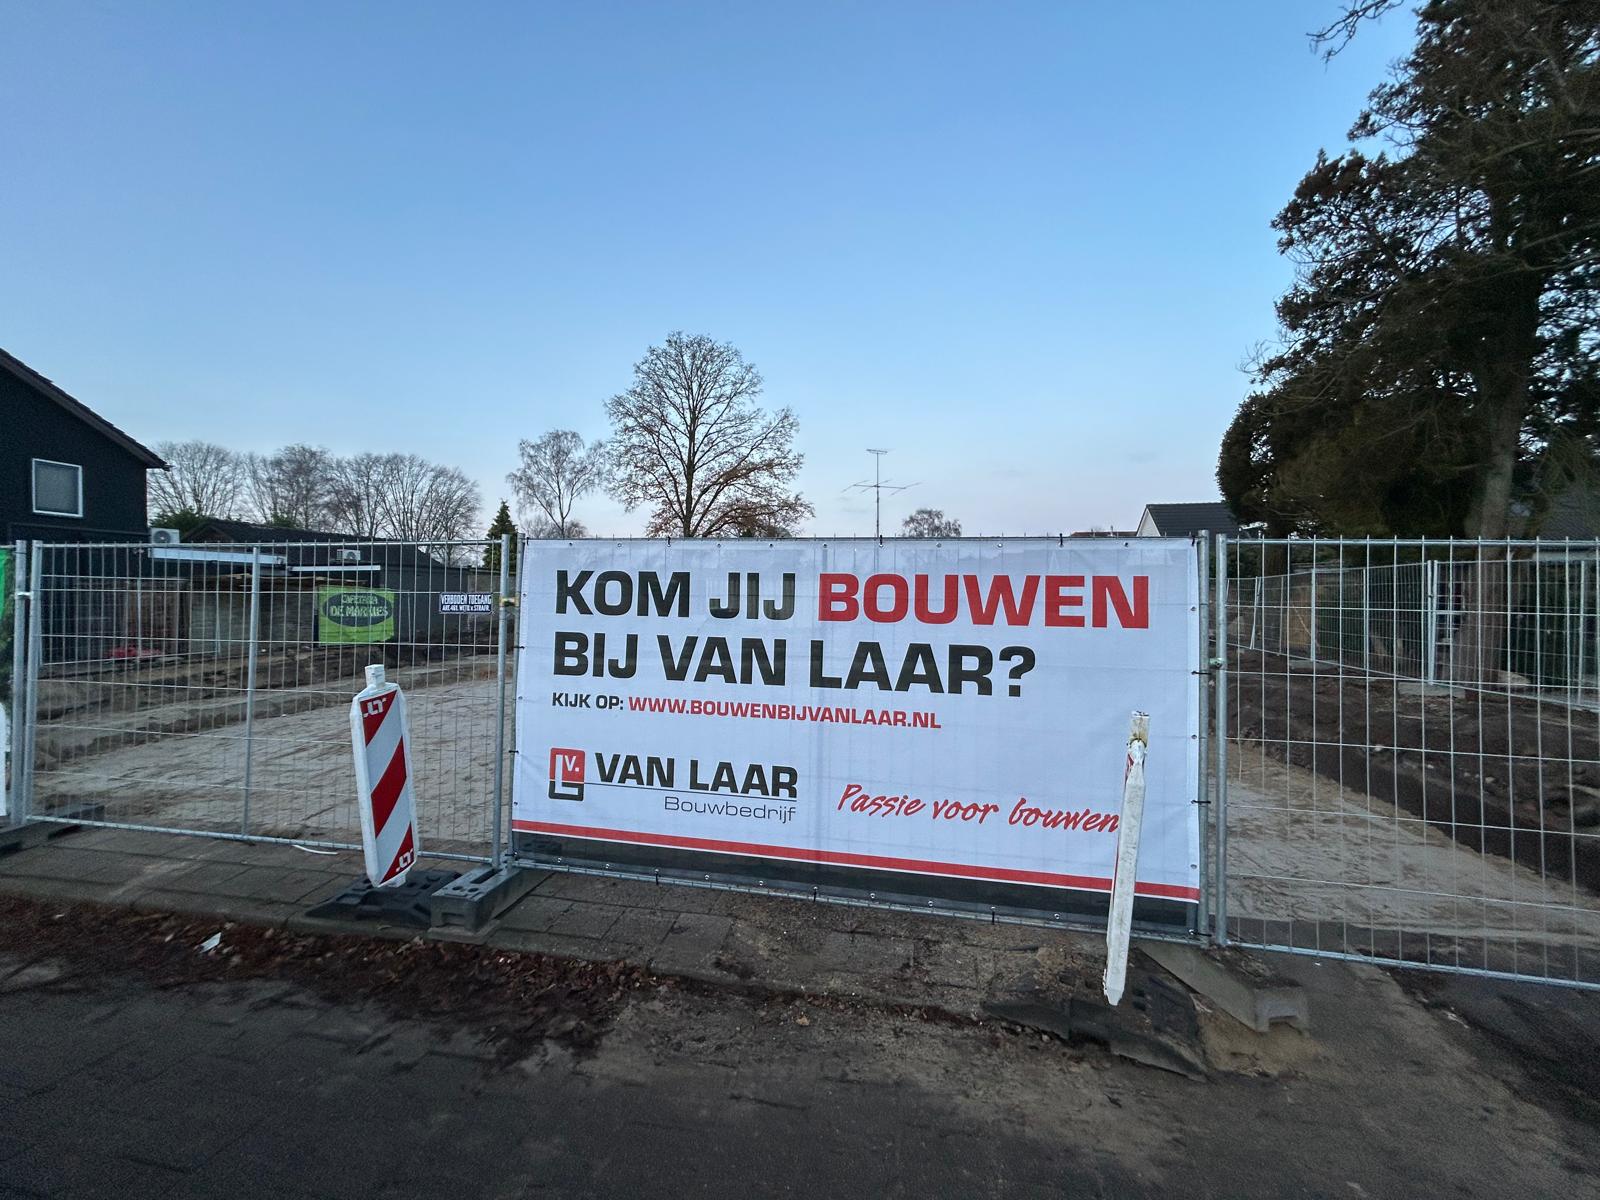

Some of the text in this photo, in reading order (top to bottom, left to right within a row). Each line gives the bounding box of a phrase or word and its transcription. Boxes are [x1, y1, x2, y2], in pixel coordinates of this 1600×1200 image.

[330, 606, 344, 617] DE
[556, 570, 1149, 629] KOM JIJ BOUWEN
[554, 632, 1036, 697] BIJ VAN LAAR?
[552, 692, 941, 729] KIJK OP: WWW.BOUWENBIJVANLAAR.NL
[595, 752, 798, 799] VAN LAAR
[664, 796, 797, 824] Bouwbedrijf
[837, 783, 1120, 833] Passie voor bouwen
